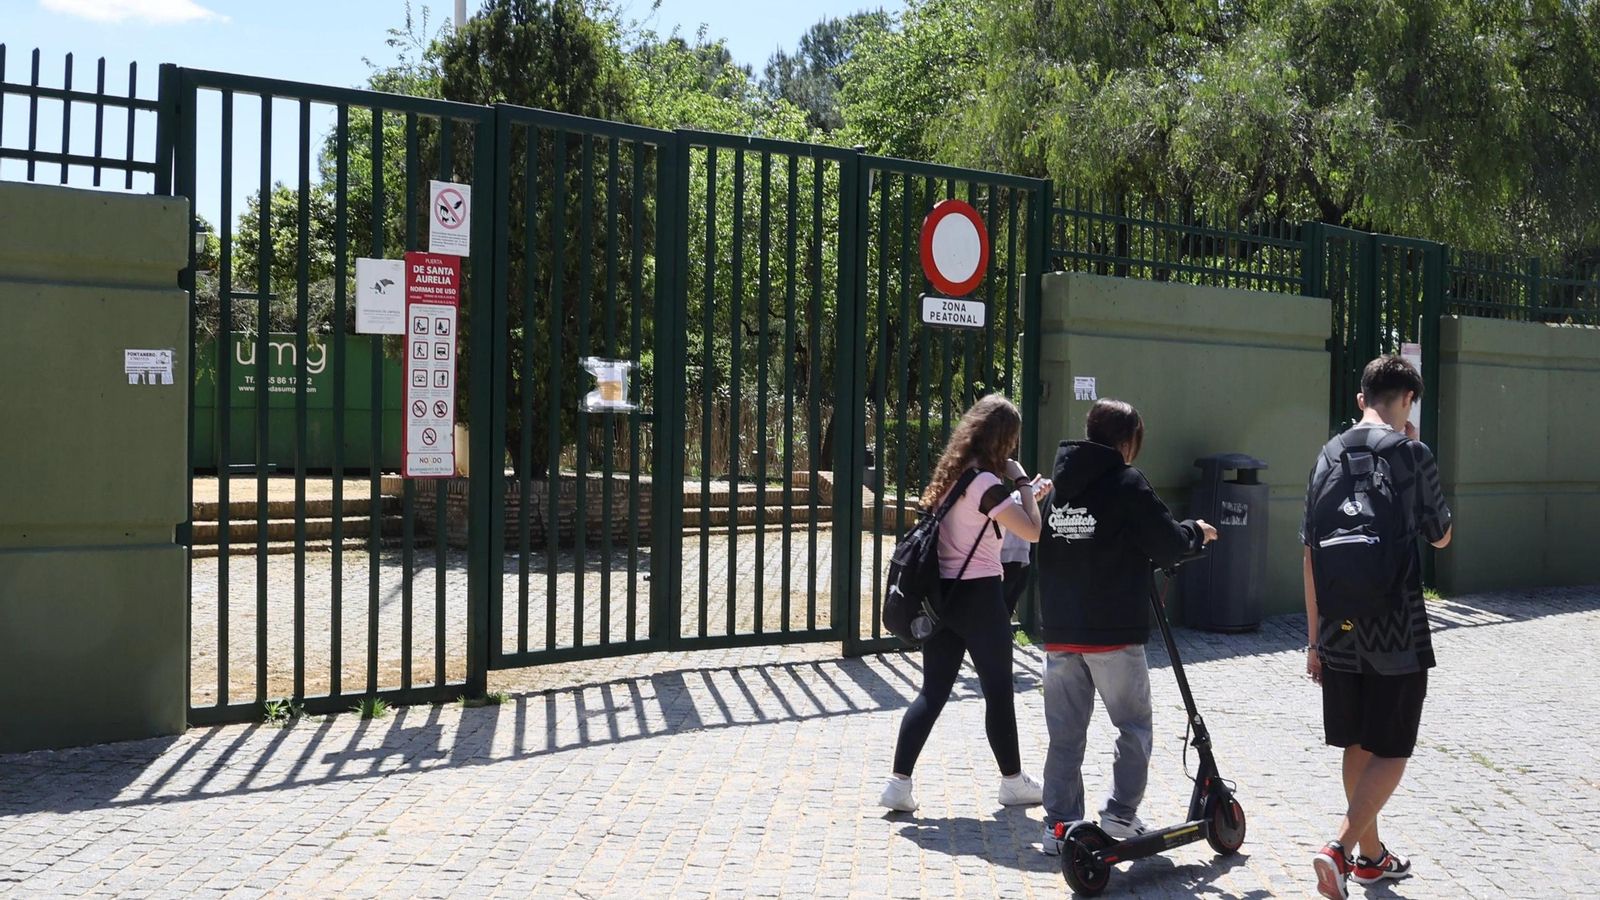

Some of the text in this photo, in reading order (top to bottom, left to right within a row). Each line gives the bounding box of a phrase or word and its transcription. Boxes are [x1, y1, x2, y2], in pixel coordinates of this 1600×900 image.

[413, 265, 454, 276] DE SANTA
[415, 274, 451, 285] AURELIA
[410, 286, 435, 294] NORMAS
[942, 301, 967, 312] ZONA
[930, 311, 978, 324] PEATONAL
[276, 377, 287, 385] 86
[1048, 513, 1097, 531] Quidditch
